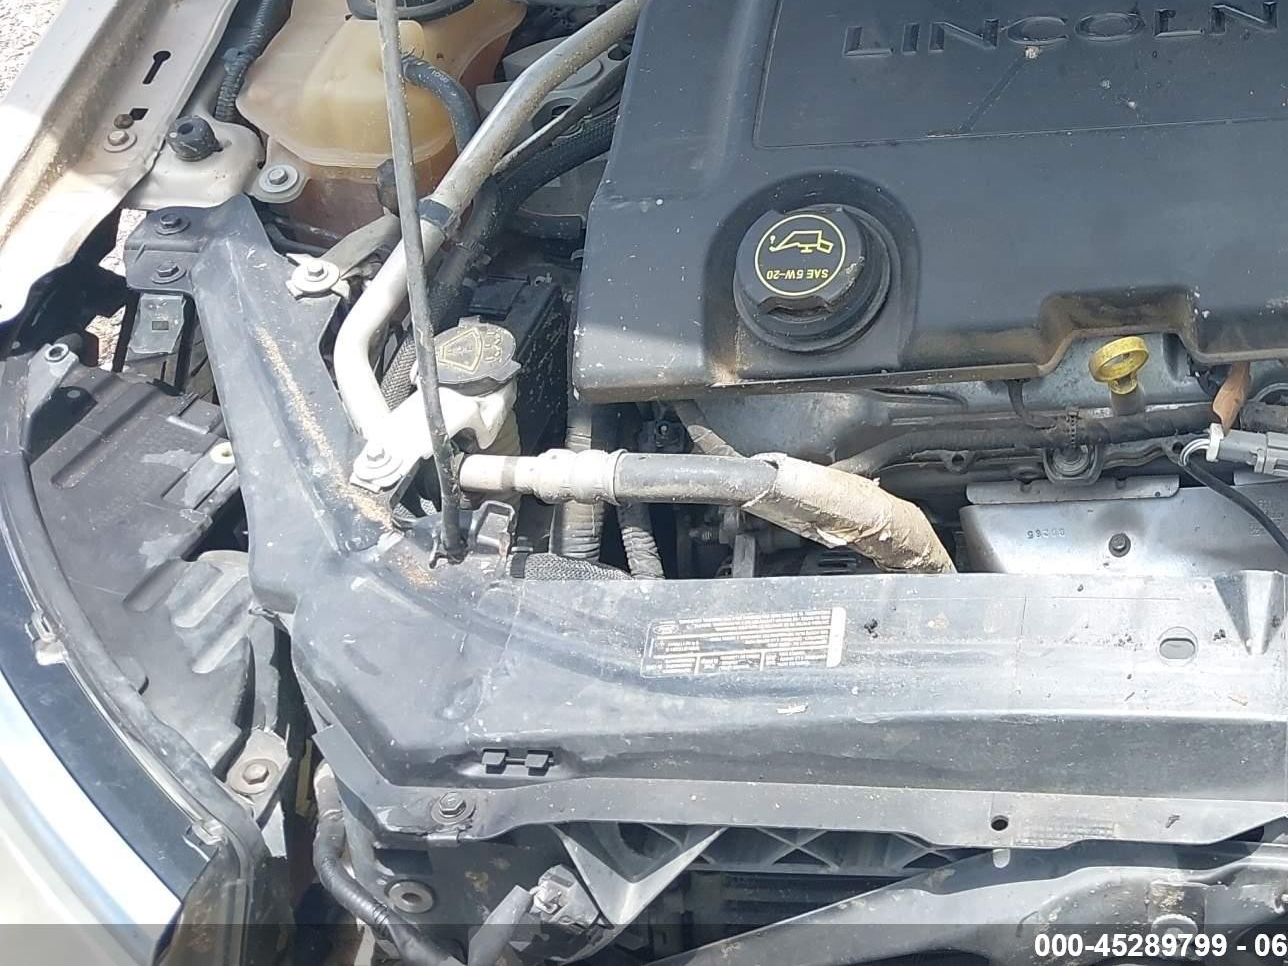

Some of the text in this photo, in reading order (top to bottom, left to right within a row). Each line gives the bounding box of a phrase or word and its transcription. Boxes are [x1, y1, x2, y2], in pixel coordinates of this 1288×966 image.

[842, 0, 1278, 57] LINCOLN
[766, 269, 829, 280] SAE 5W-20
